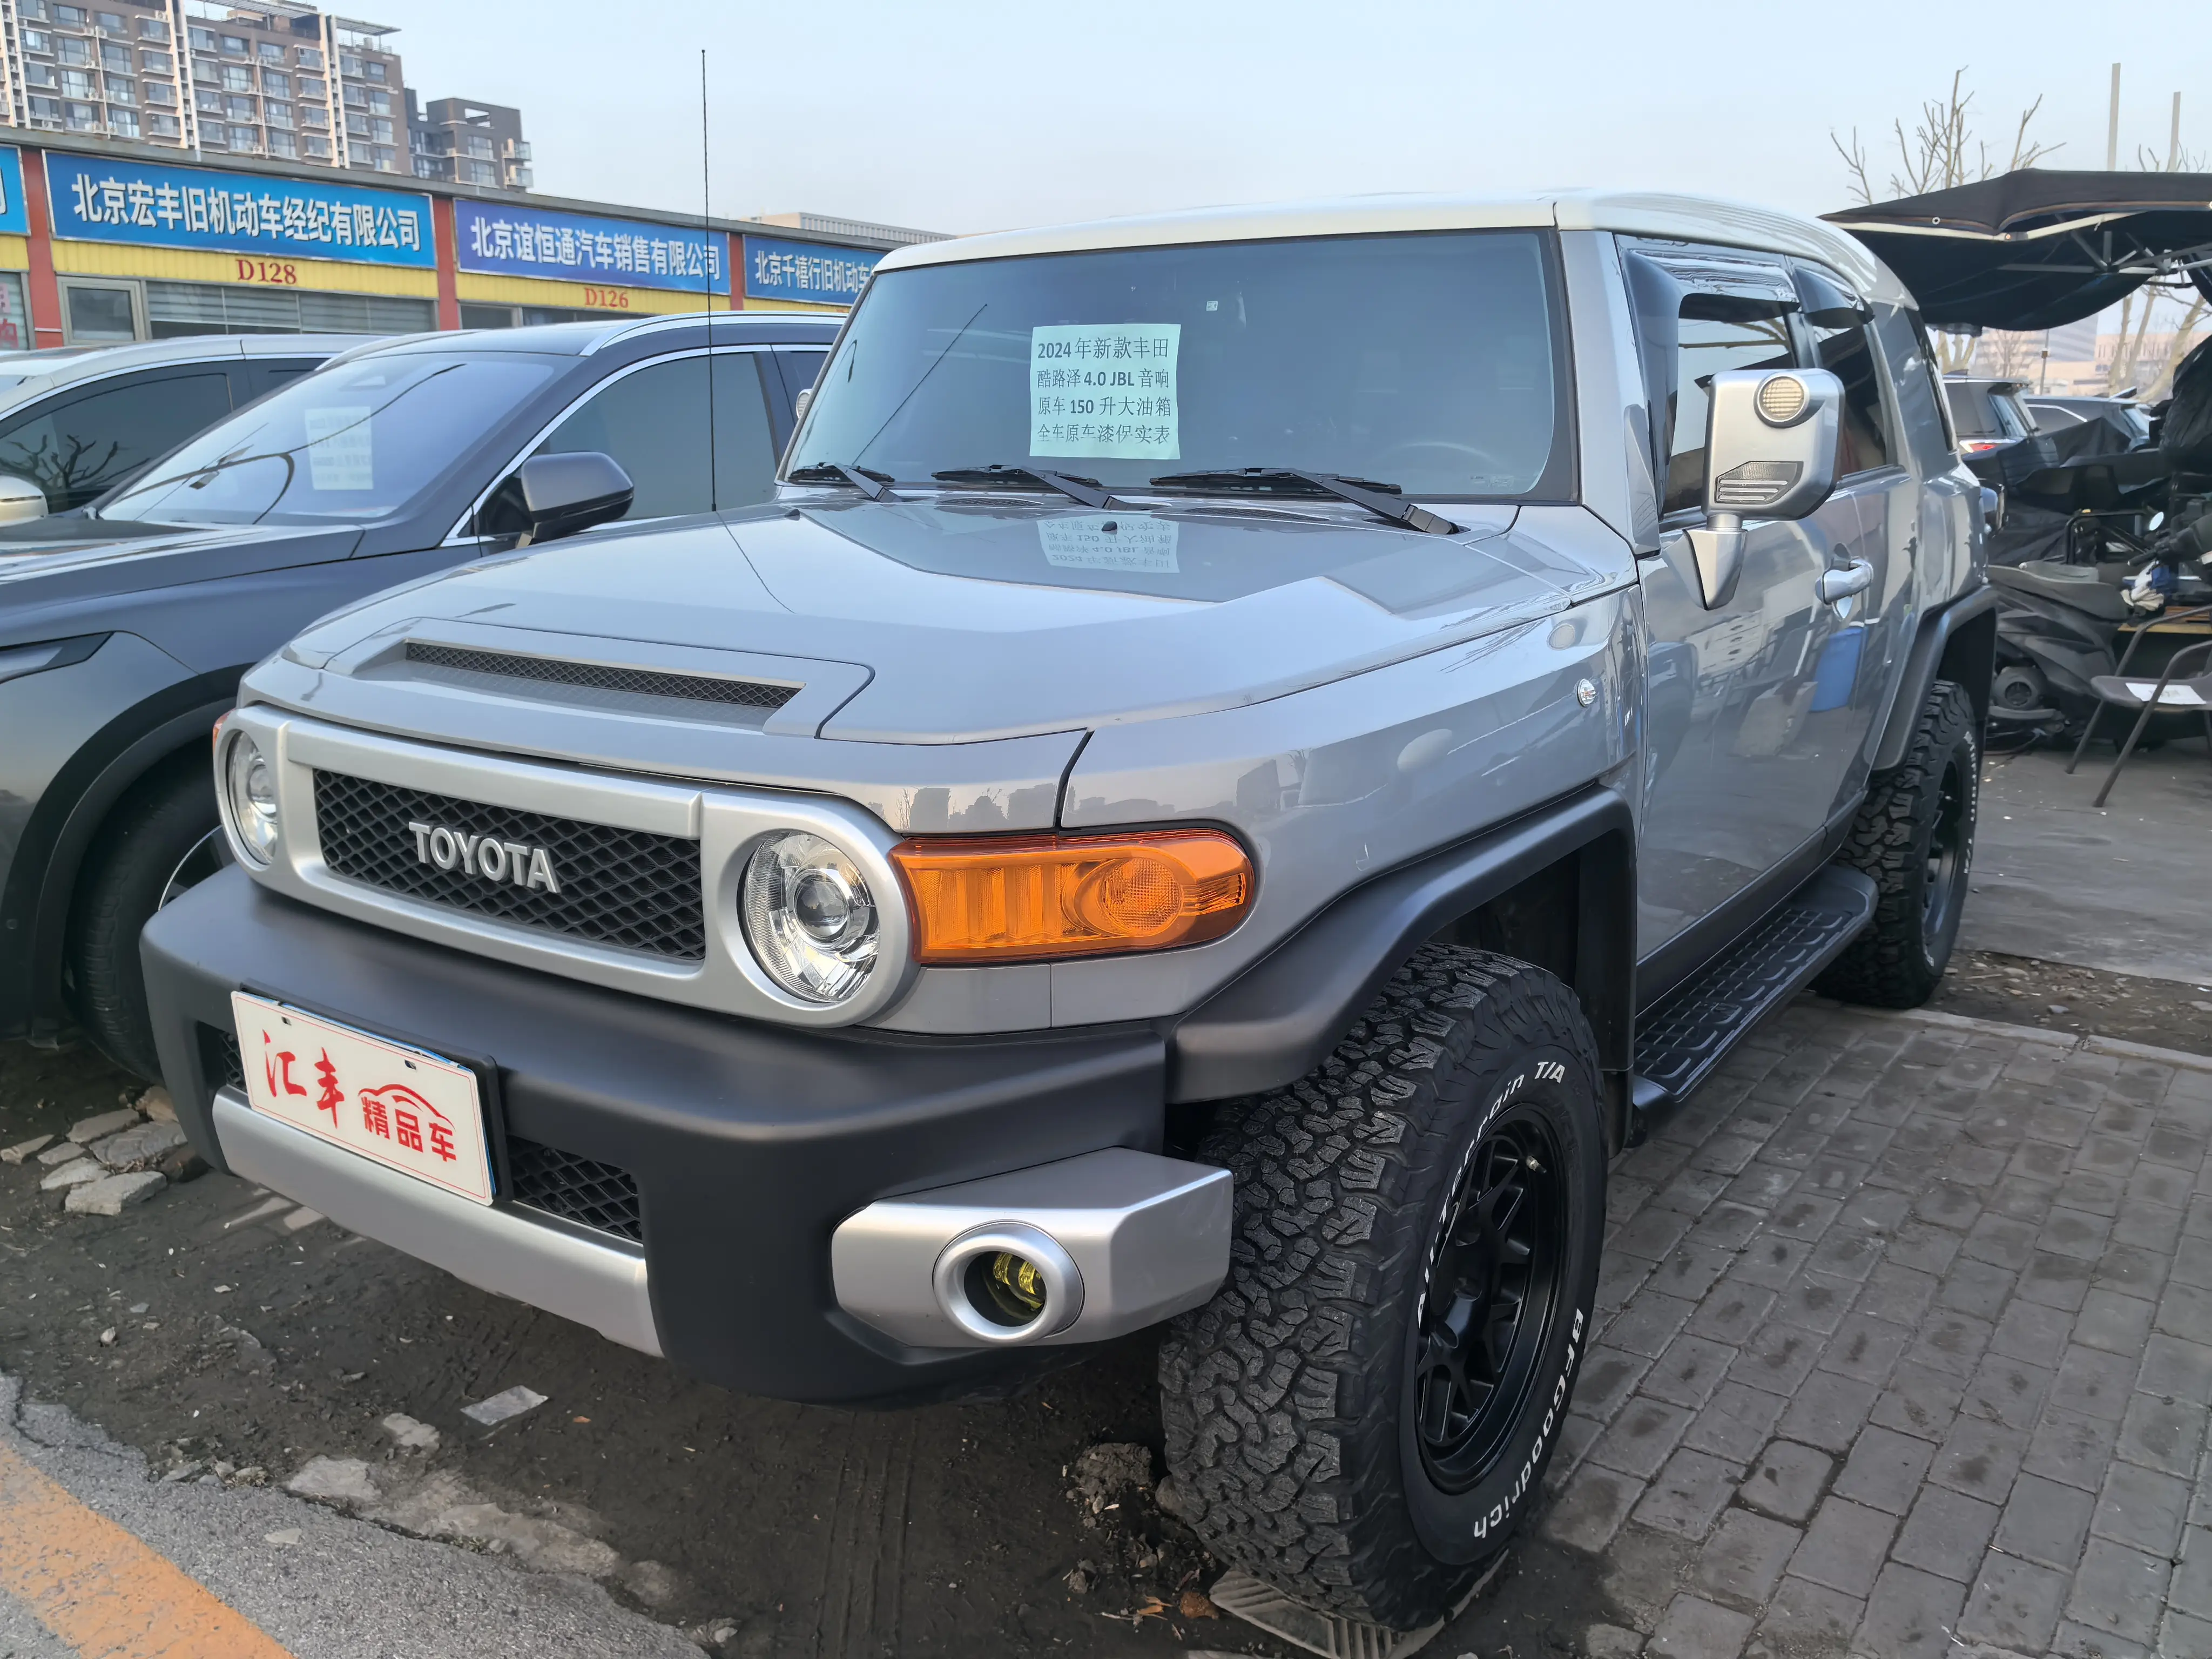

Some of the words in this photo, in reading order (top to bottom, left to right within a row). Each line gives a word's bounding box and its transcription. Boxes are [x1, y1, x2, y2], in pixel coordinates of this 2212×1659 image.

[71, 173, 421, 252] 北京宏丰旧机动车经纪有限公司
[236, 259, 297, 285] D128
[470, 216, 720, 280] 北京谊恒通汽车销售有限公司
[755, 250, 875, 293] 北京千禧行旧机动车
[584, 287, 629, 308] D126
[1037, 423, 1170, 444] 全车原车漆保实表
[409, 821, 561, 893] TOYOTA
[1534, 1061, 1566, 1084] T/A
[361, 1096, 456, 1162] 精品车
[1474, 1308, 1583, 1539] BFGoodrich
